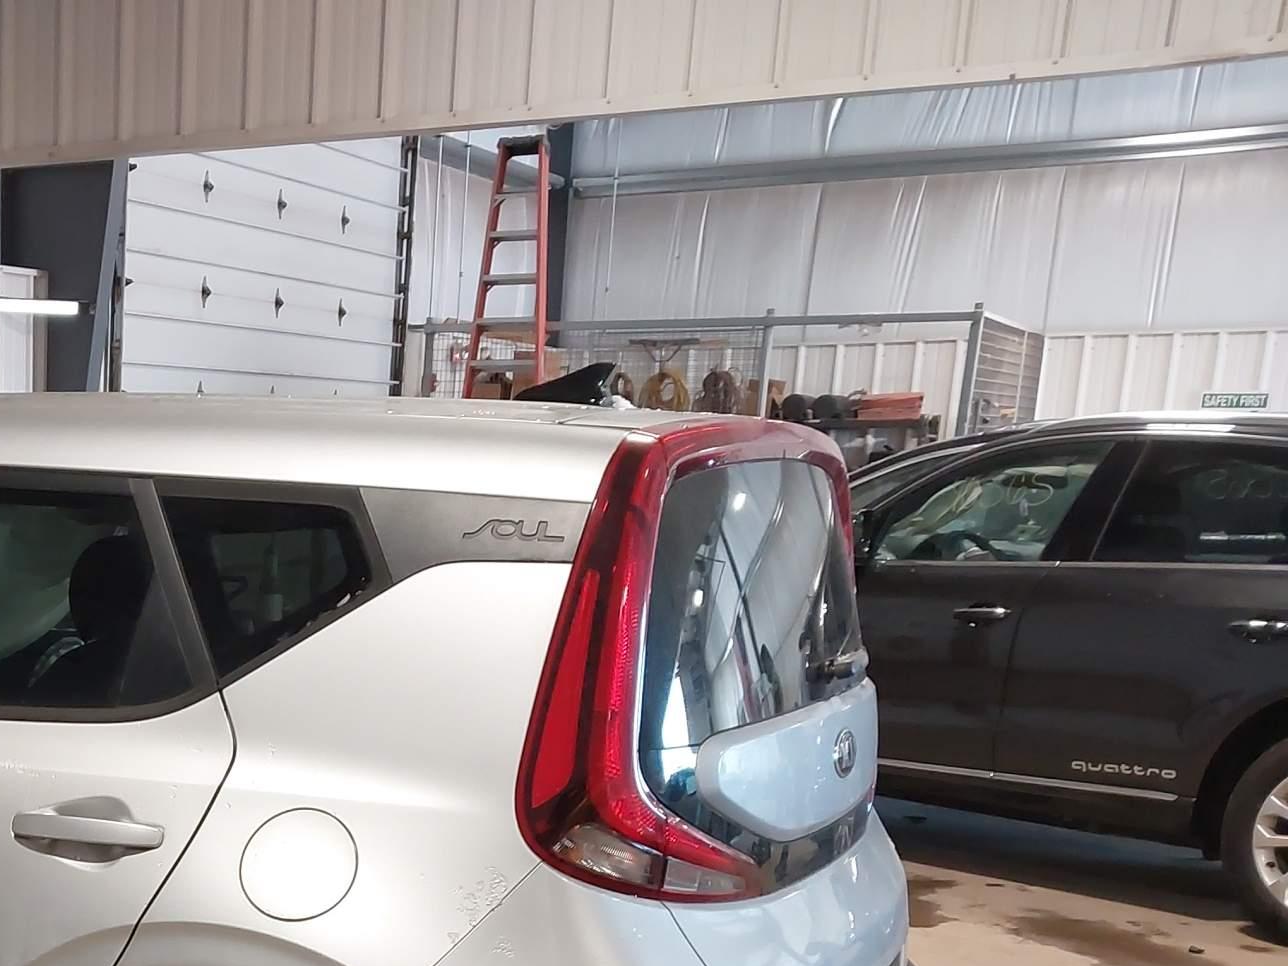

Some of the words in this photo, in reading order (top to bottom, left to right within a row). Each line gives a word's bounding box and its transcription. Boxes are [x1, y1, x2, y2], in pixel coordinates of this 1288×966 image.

[1203, 395, 1239, 407] SAFETY
[1239, 395, 1266, 407] FIRST
[463, 519, 565, 542] SOUL
[1071, 760, 1177, 779] quattro
